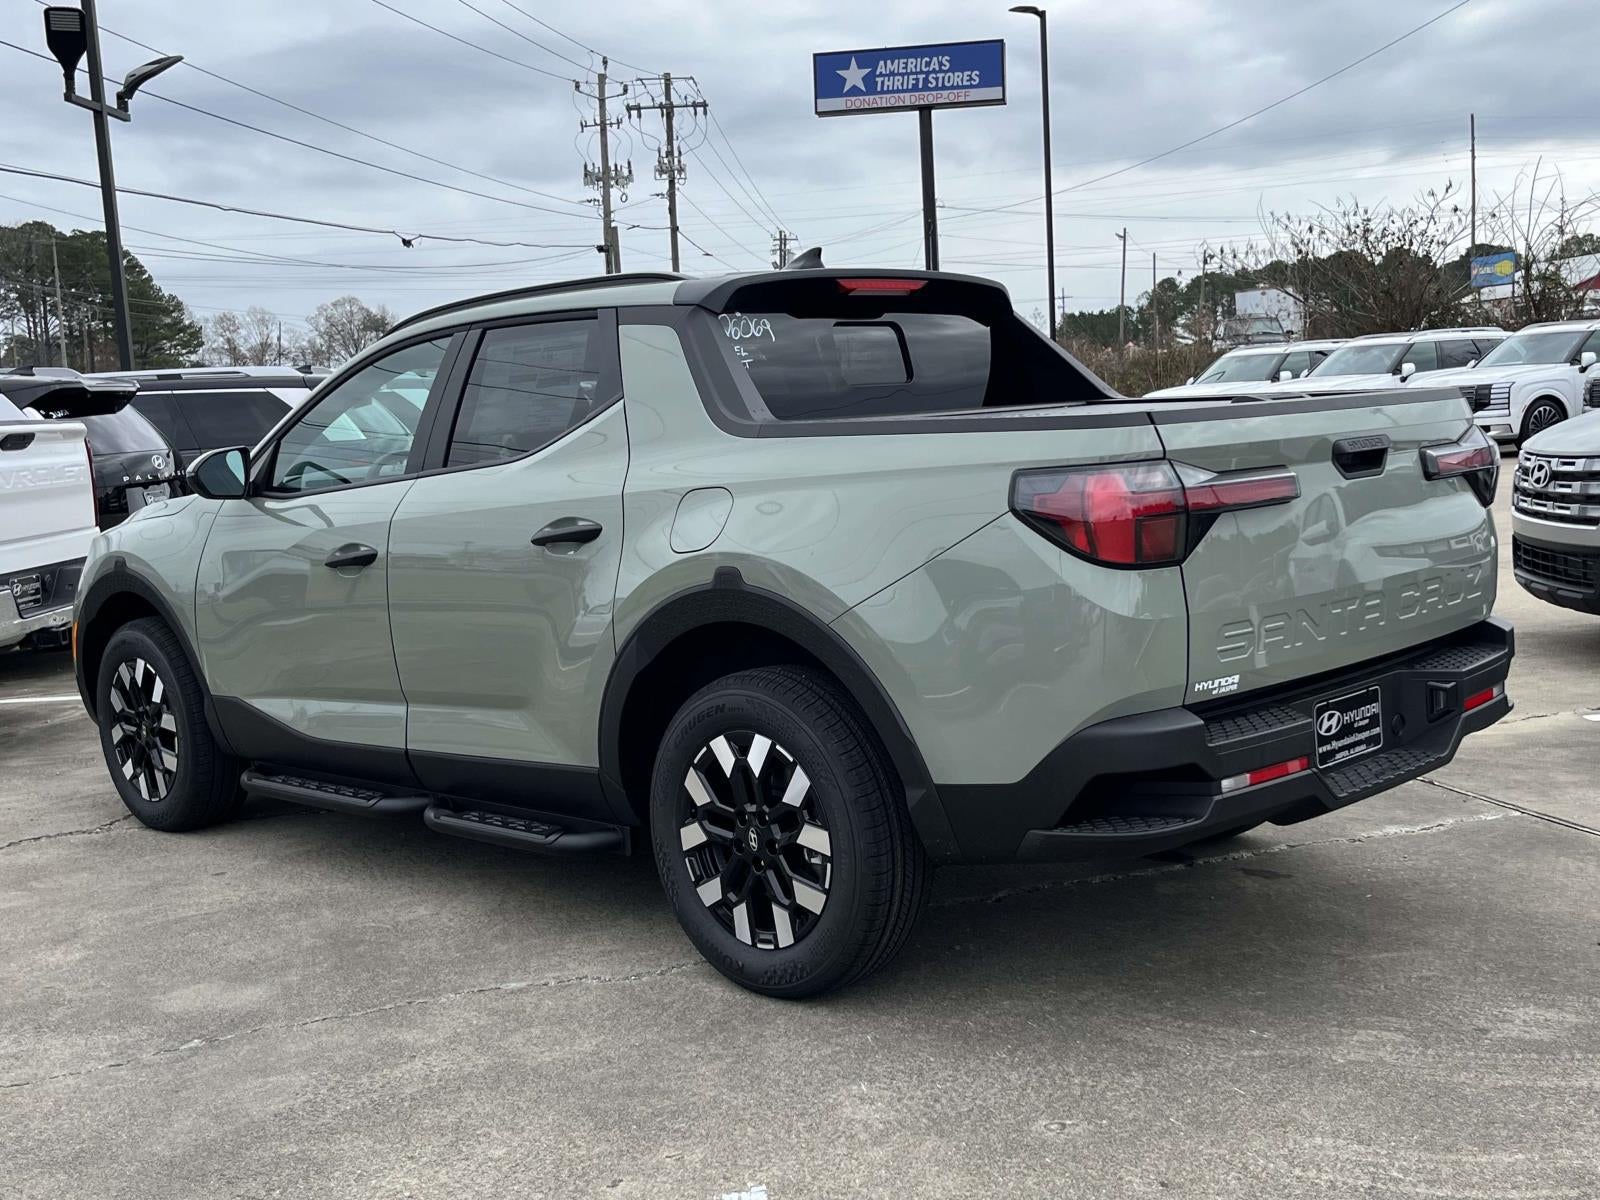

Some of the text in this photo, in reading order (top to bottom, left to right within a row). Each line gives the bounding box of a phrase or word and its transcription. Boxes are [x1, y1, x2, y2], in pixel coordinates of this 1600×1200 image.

[876, 56, 950, 75] AMERICA'S
[876, 70, 980, 91] THRIFT STORES
[845, 91, 971, 109] DONATION DROP-OFF
[1215, 563, 1483, 663] SANTA CRUZ
[1194, 674, 1241, 692] HYUNDAI
[1343, 702, 1380, 725] HYUNDAI
